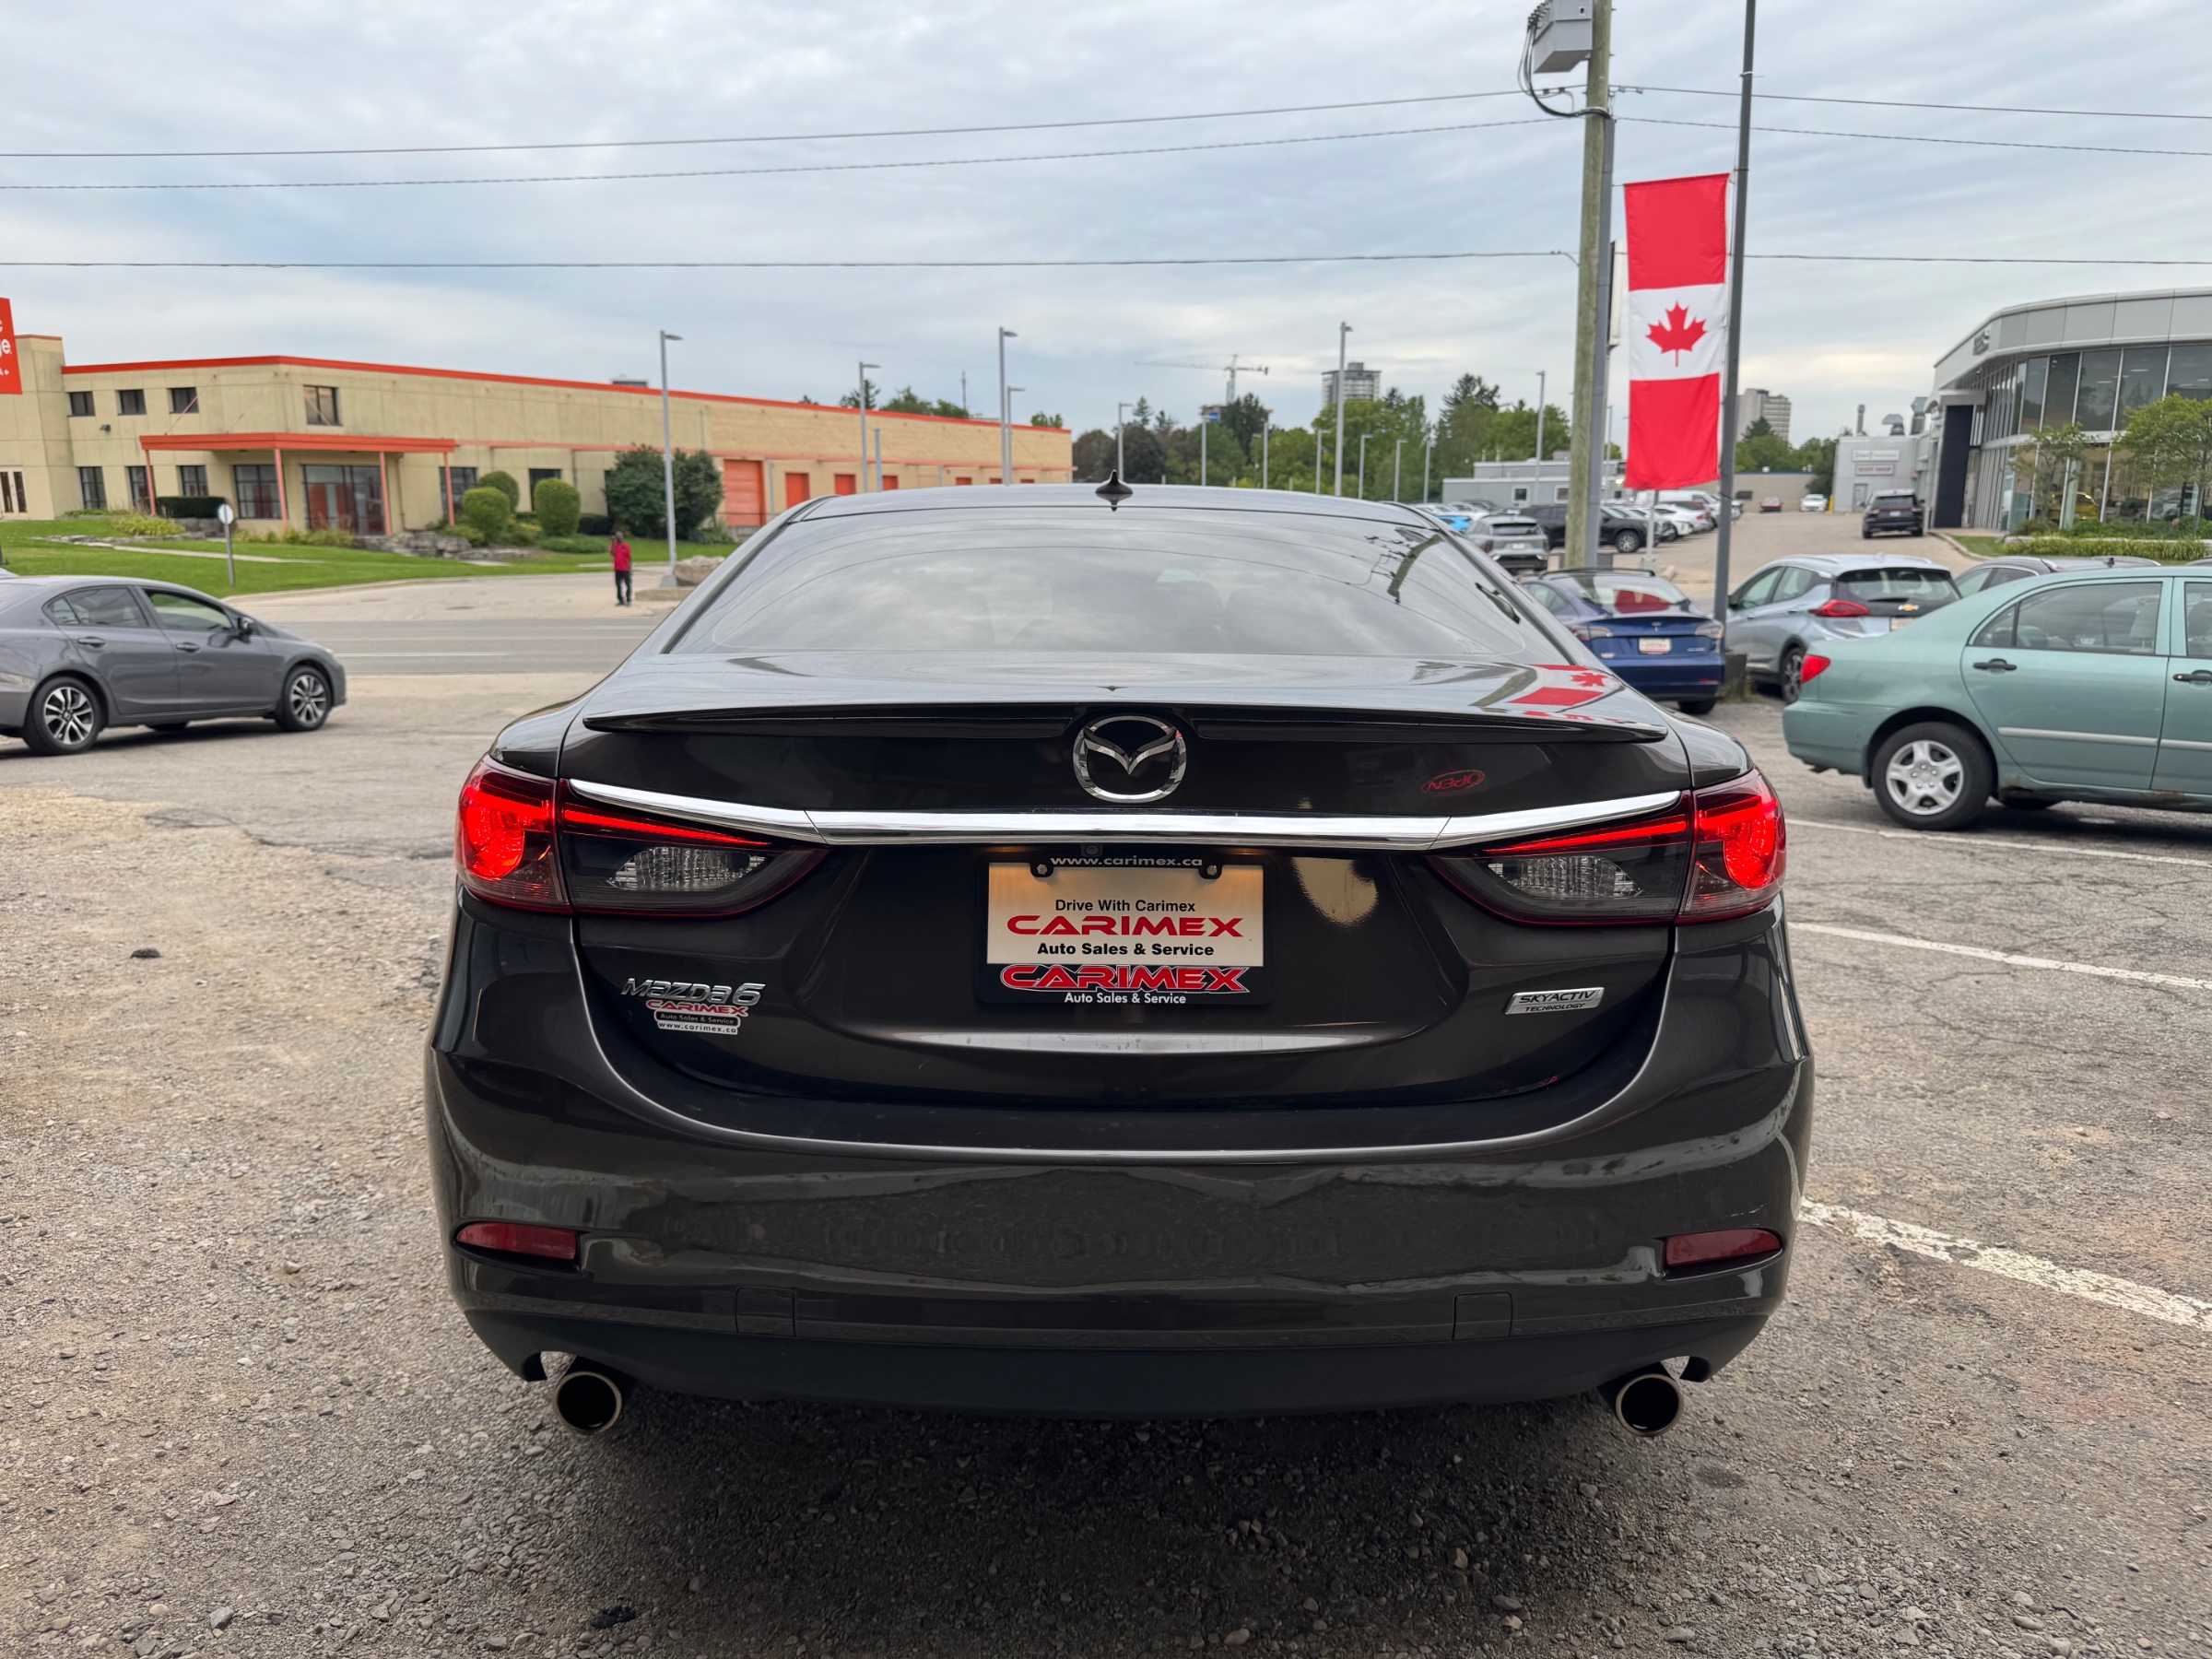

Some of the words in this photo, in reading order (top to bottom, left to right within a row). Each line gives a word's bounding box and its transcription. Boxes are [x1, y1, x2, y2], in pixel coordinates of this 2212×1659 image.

[1426, 772, 1483, 793] OPEN
[1050, 855, 1203, 866] www.carimex.ca
[1055, 900, 1094, 912] Drive
[1098, 900, 1131, 912] With
[1135, 900, 1196, 912] Carimex
[1006, 914, 1244, 937] CARIMEX
[1037, 943, 1077, 955] Auto
[1081, 943, 1128, 955] Sales
[1133, 943, 1147, 955] &
[1151, 943, 1215, 956] Service
[1001, 964, 1248, 993] CARIMEX
[1065, 992, 1093, 1003] Auto
[1096, 992, 1129, 1004] Sales
[1132, 993, 1141, 1004] &
[1144, 993, 1186, 1004] Service
[1518, 991, 1596, 1004] SKYACTIV
[647, 1000, 747, 1016] CARIMEX
[1524, 1003, 1586, 1012] TECHNOLOGY
[708, 1017, 735, 1025] Service
[658, 1022, 736, 1033] www.carimex.ca
